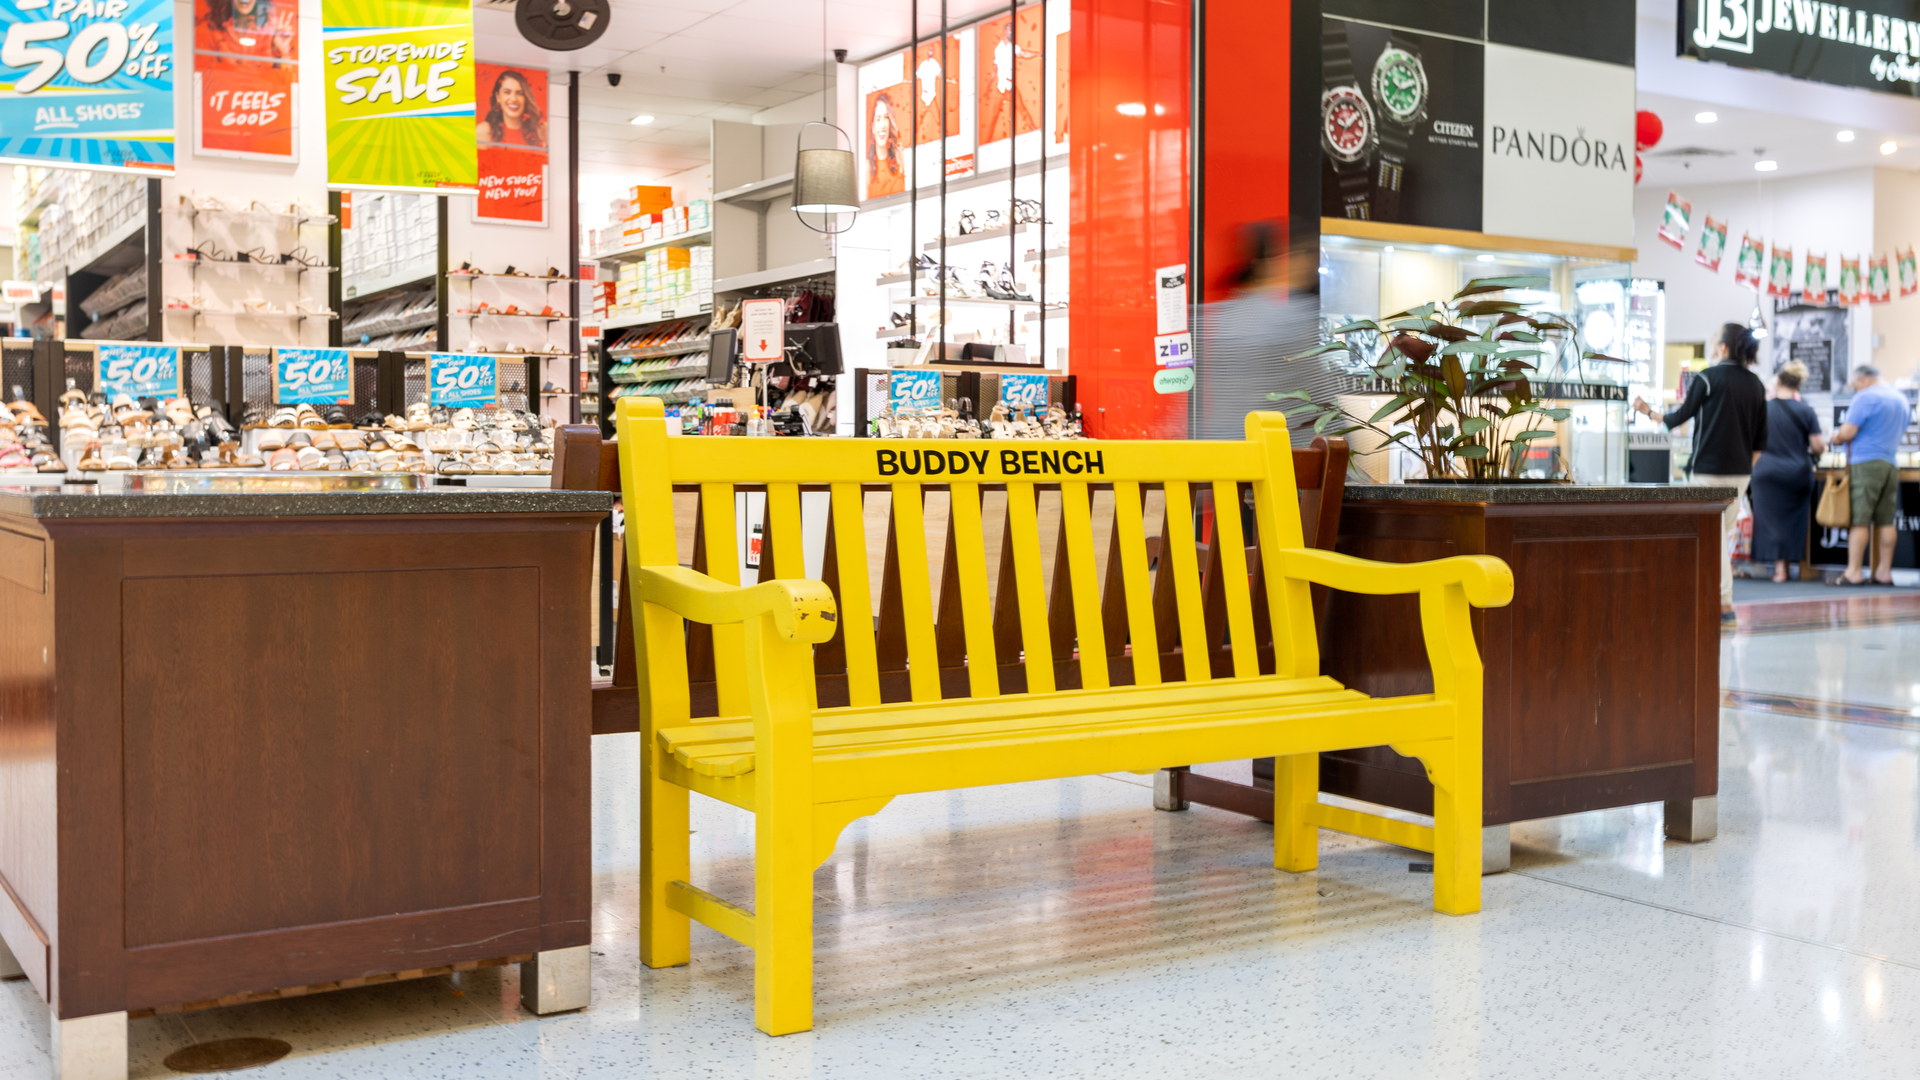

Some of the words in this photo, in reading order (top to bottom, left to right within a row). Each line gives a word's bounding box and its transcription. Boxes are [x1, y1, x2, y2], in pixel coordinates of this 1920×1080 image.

[52, 0, 128, 22] PAIR
[1, 20, 160, 94] 50%
[328, 40, 467, 65] STOREWIDE
[126, 54, 169, 79] OFF
[335, 60, 459, 105] SALE
[210, 90, 230, 112] IT
[231, 90, 286, 110] FEELS
[35, 105, 74, 124] ALL
[221, 110, 278, 126] GOOD
[1433, 120, 1474, 138] CITIZEN
[1492, 125, 1627, 172] PANDORA
[479, 175, 504, 188] NEW
[506, 174, 542, 186] SHOES,
[485, 188, 511, 200] NEW
[514, 186, 538, 198] YOU!
[107, 356, 171, 390] 50%
[157, 368, 174, 380] OFF
[285, 359, 343, 391] 50%
[330, 370, 346, 381] OFF
[436, 365, 490, 395] 50%
[478, 376, 493, 386] OFF
[895, 379, 936, 405] 50%
[1006, 382, 1045, 403] 50%
[1562, 384, 1597, 398] MAKE
[1601, 385, 1624, 399] UPS
[876, 449, 990, 475] BUDDY
[1000, 450, 1105, 475] BENCH
